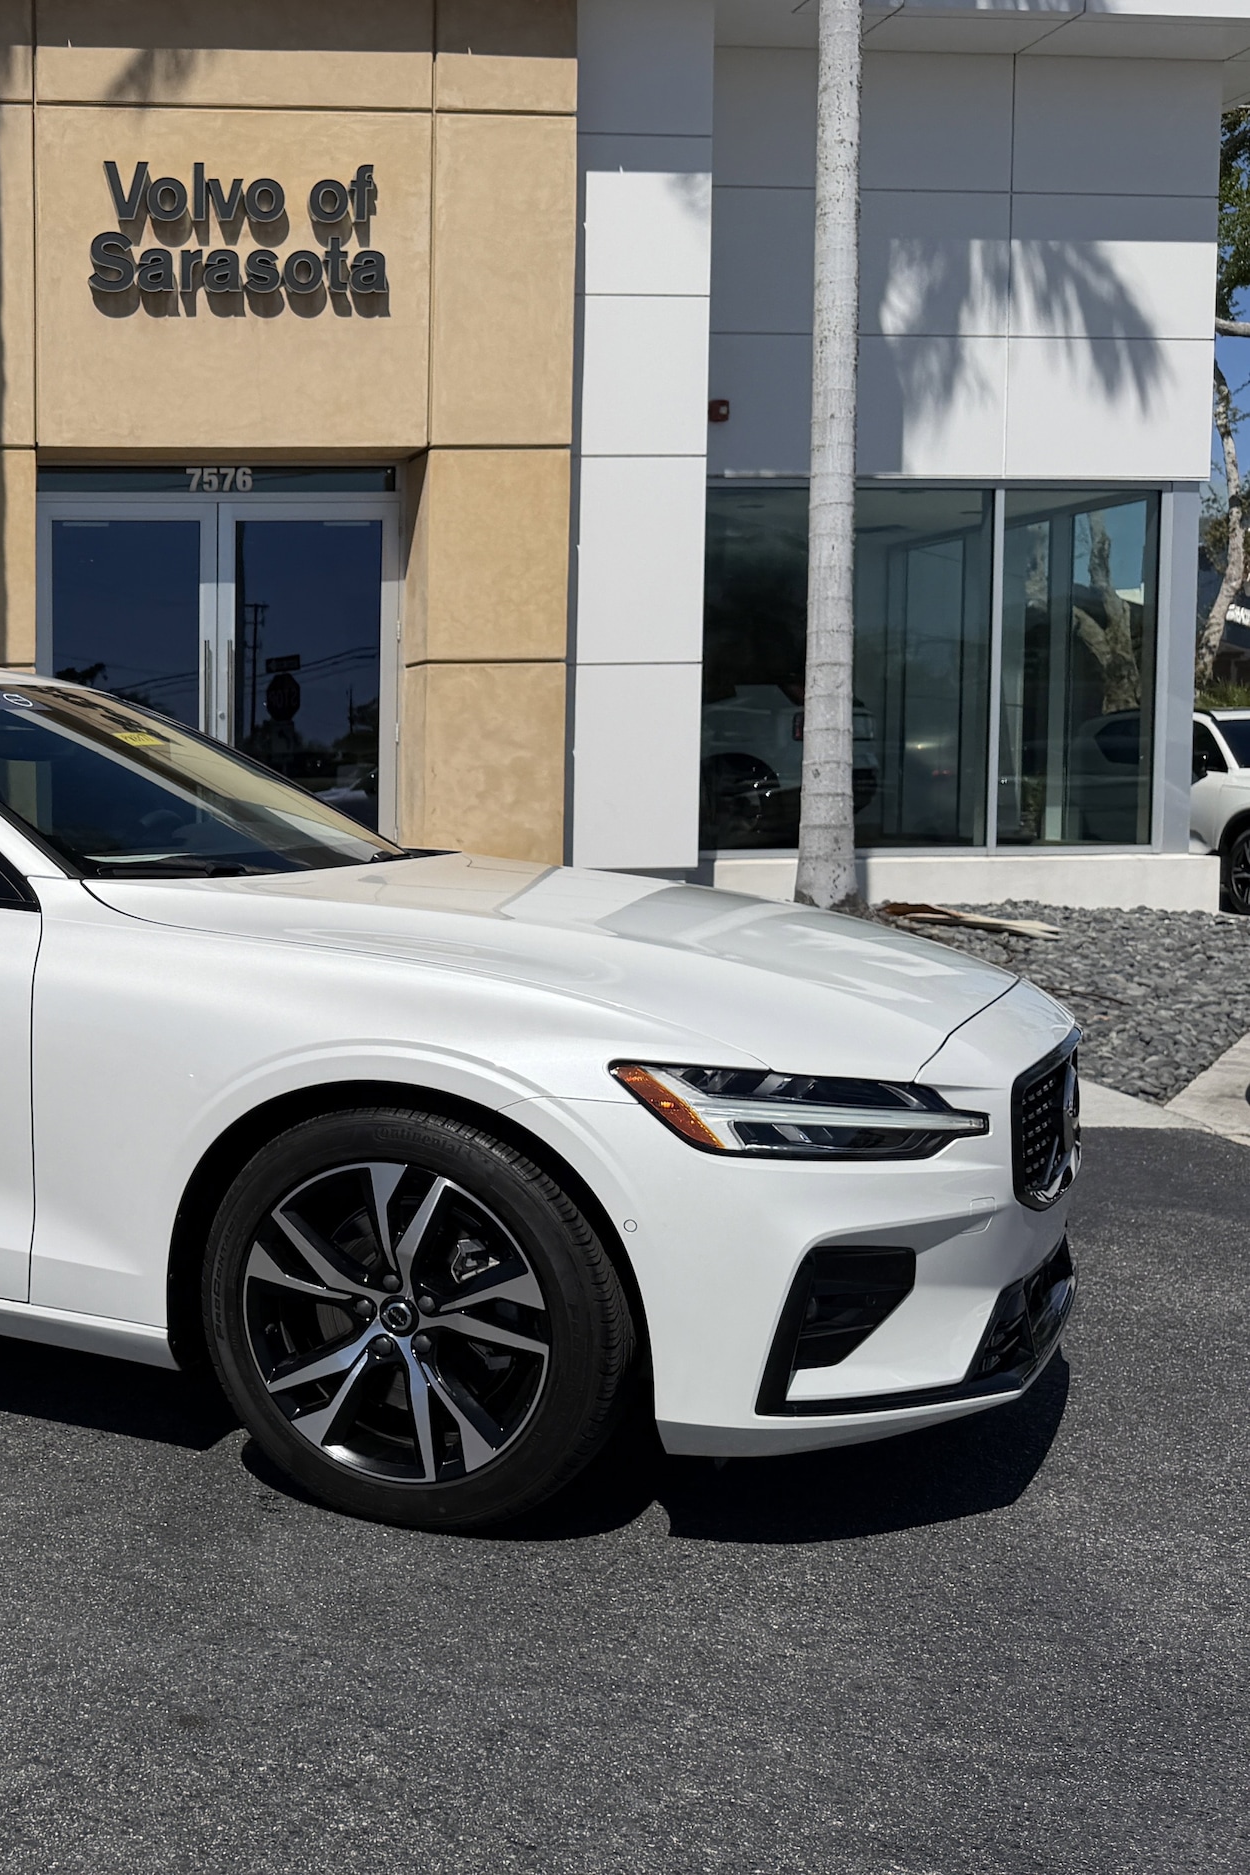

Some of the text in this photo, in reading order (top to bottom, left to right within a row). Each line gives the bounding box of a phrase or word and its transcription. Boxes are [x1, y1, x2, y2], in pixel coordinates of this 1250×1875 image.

[103, 160, 375, 222] Volvo of
[87, 231, 389, 294] Sarasota
[185, 467, 253, 492] 7576
[374, 1125, 462, 1155] Continental
